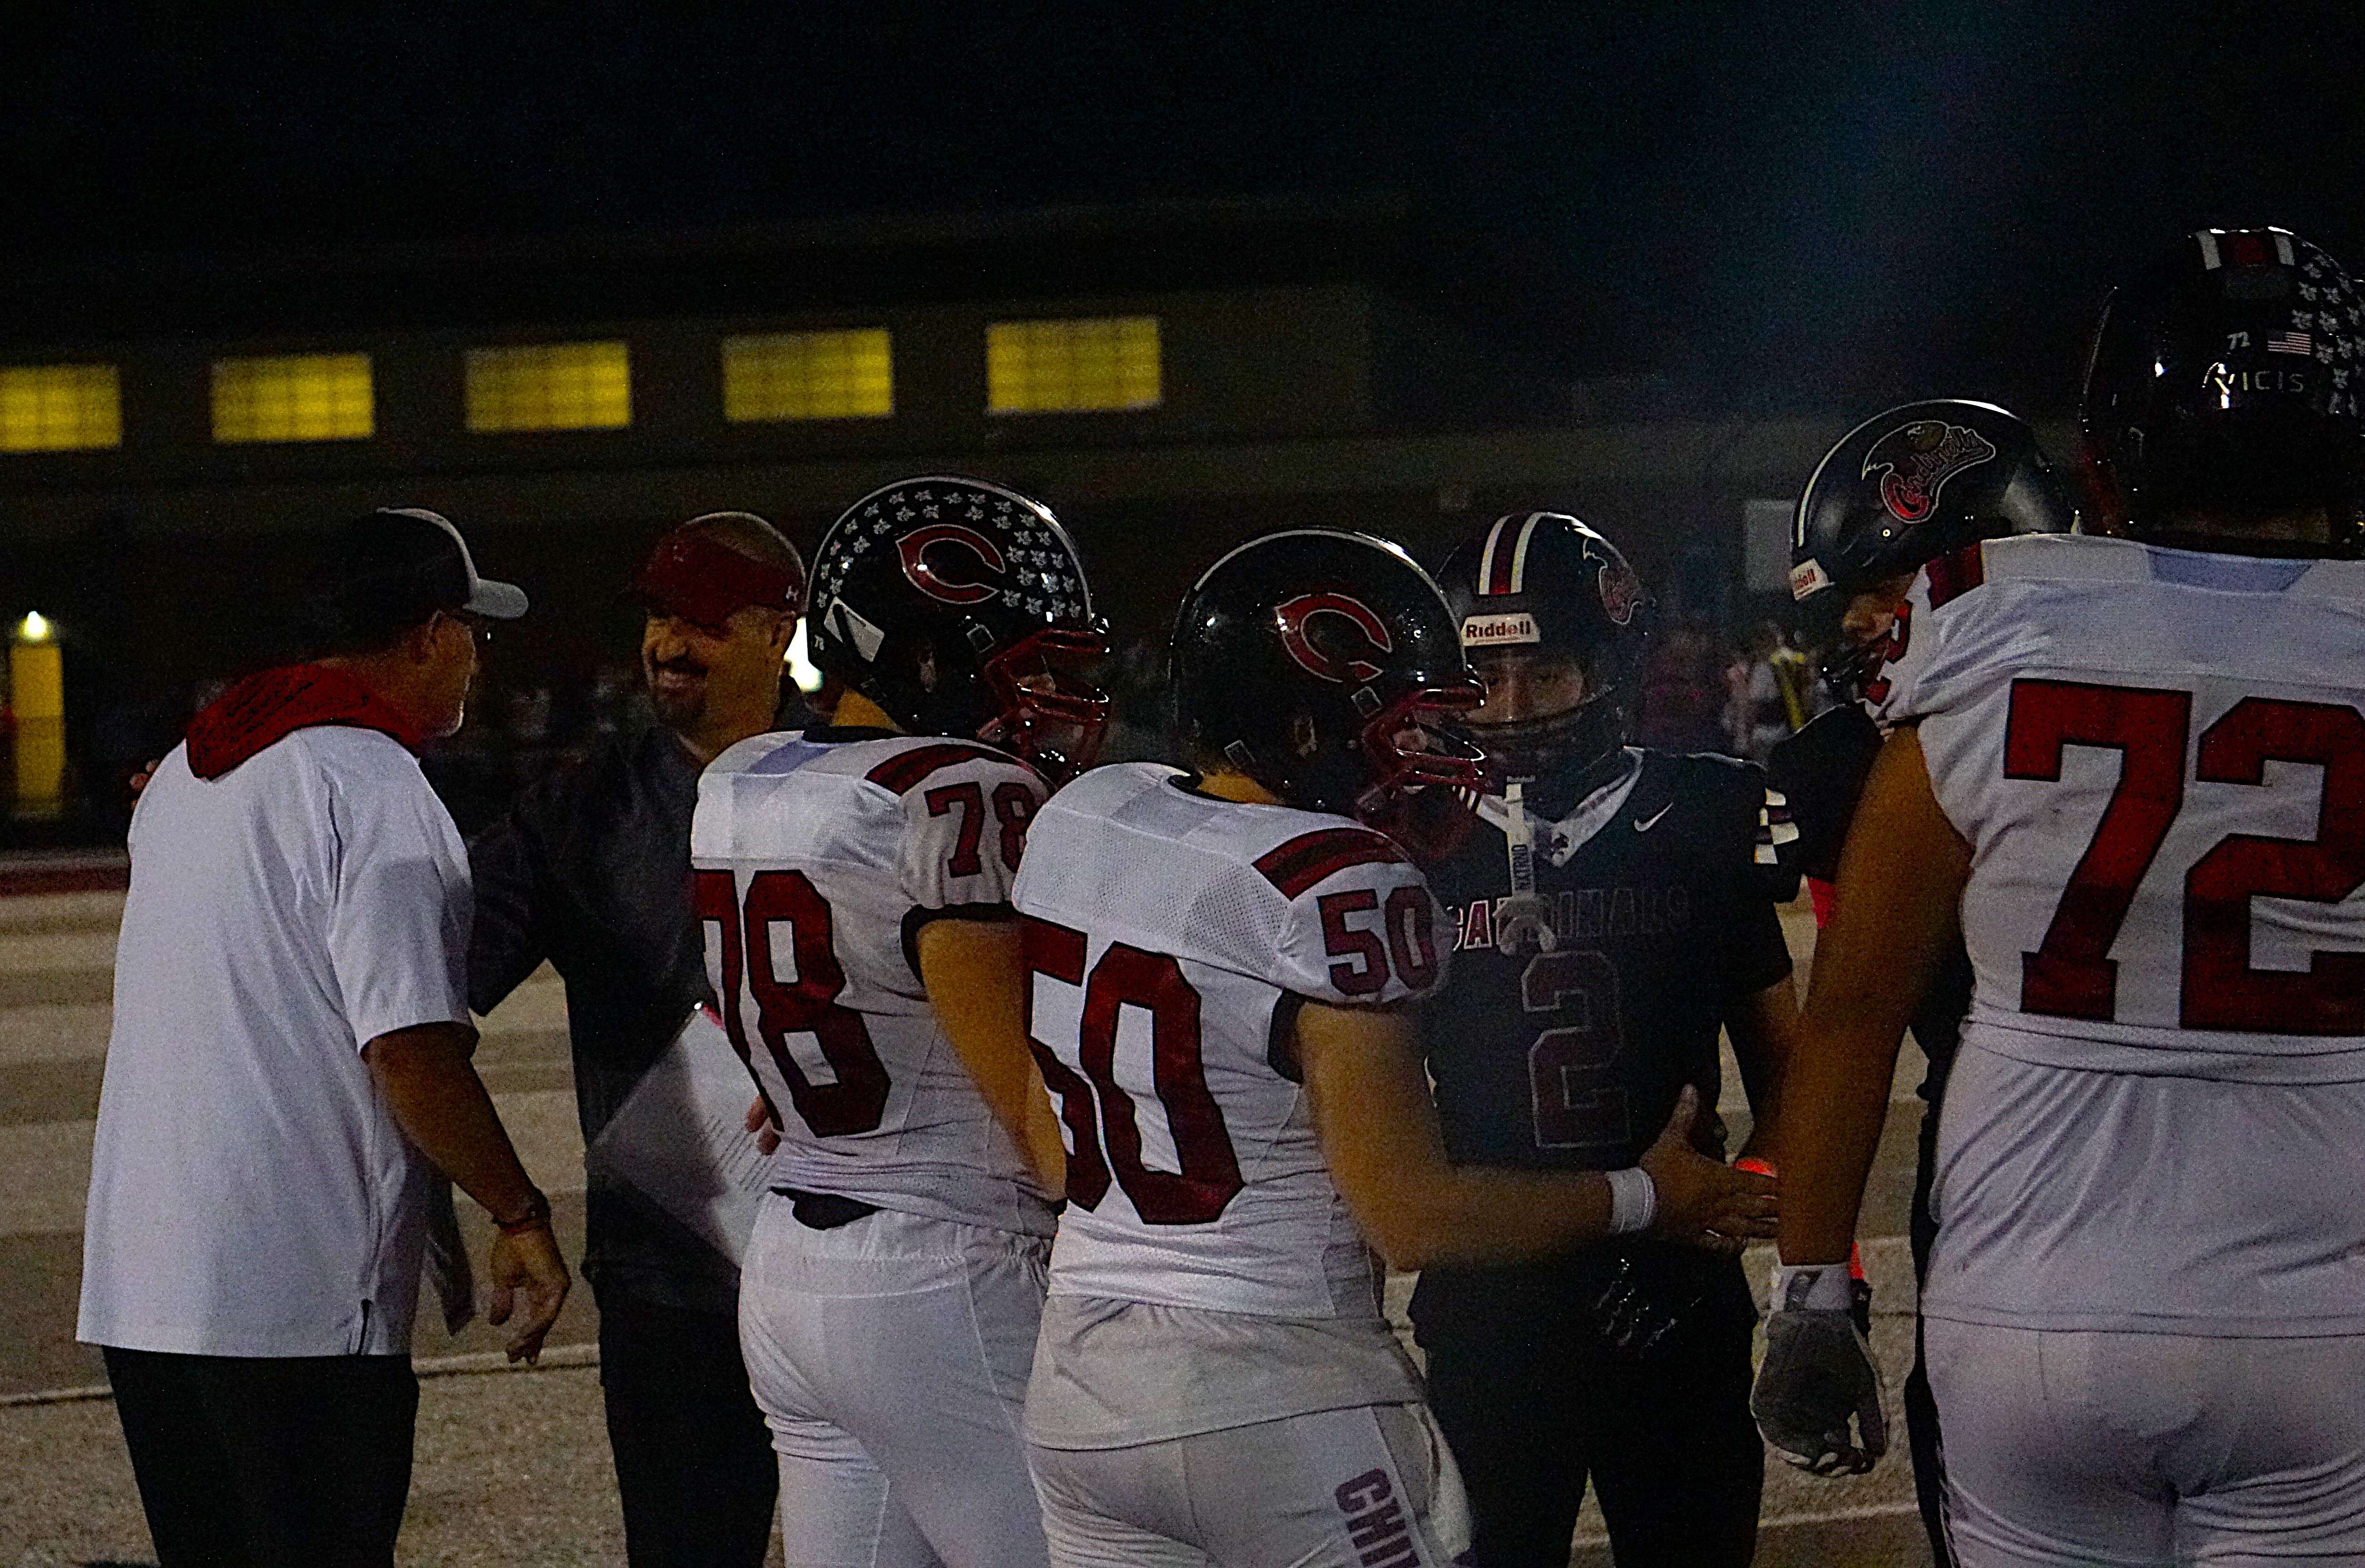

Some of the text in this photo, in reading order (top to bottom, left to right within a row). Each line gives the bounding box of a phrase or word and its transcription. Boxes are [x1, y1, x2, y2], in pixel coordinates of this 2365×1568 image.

[895, 523, 1006, 604] C
[1274, 592, 1393, 683] C
[1466, 621, 1531, 639] Riddell
[925, 781, 1037, 877] 78
[2004, 678, 2365, 1037] 72
[1316, 886, 1438, 996] 50
[693, 870, 891, 1138] 78
[1521, 948, 1631, 1148] 2
[1022, 913, 1246, 1225] 50
